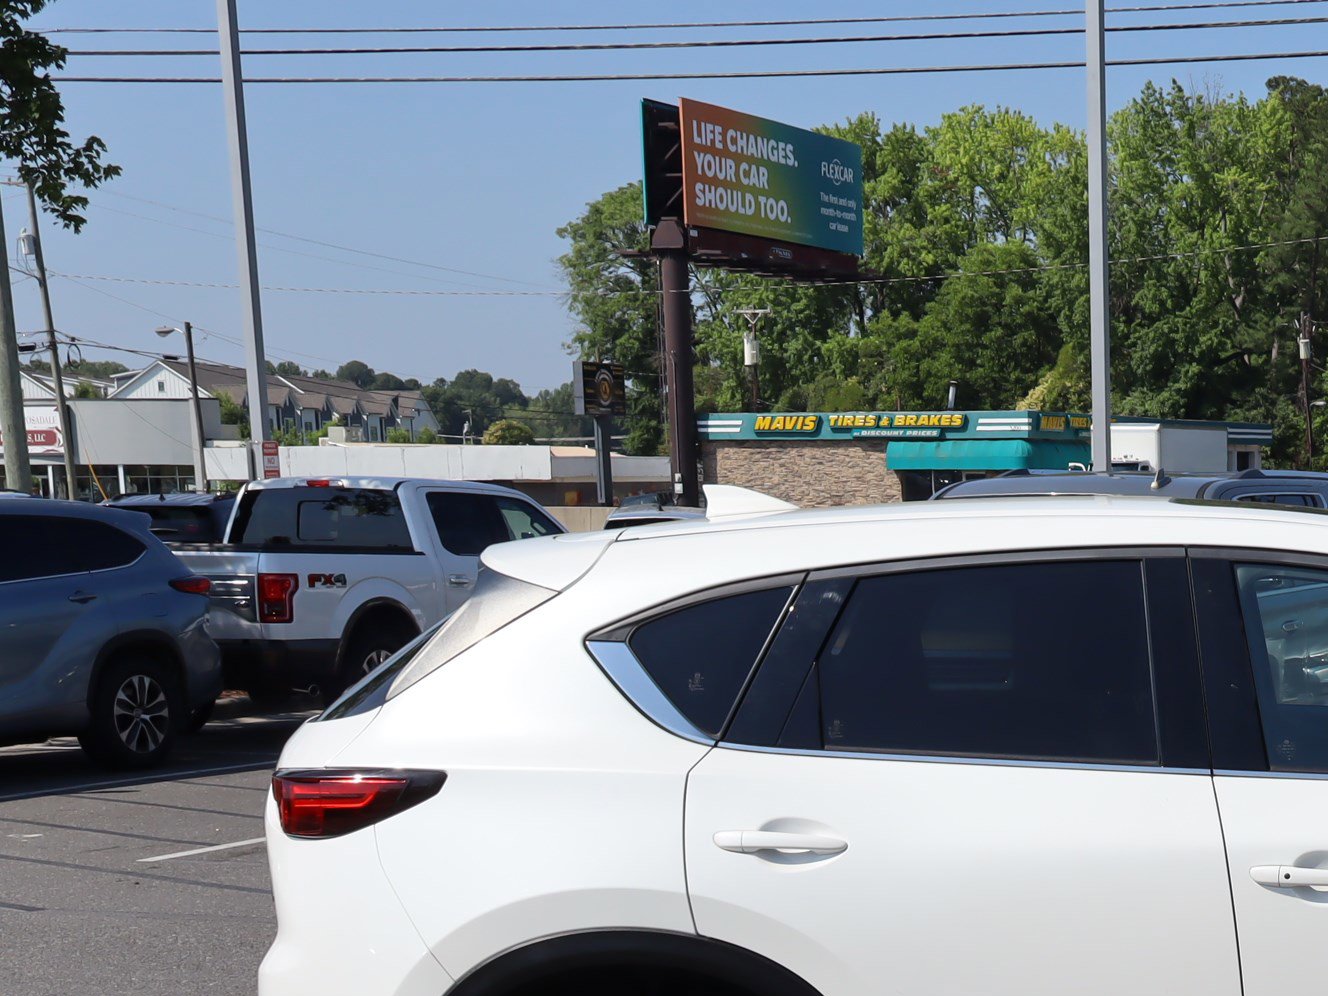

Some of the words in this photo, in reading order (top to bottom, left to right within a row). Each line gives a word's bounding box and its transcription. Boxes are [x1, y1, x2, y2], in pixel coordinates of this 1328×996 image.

[693, 120, 723, 149] LIFE
[726, 129, 798, 168] CHANGES.
[693, 151, 736, 183] YOUR
[740, 162, 768, 189] CAR
[821, 161, 854, 184] FLEXCAR
[695, 182, 756, 215] SHOULD
[758, 195, 791, 223] TOO.
[753, 415, 818, 431] MAVIS
[828, 414, 877, 427] TIRES
[878, 415, 890, 427] &
[893, 414, 963, 427] BRAKES
[1039, 415, 1066, 431] MAVIS
[307, 573, 347, 588] FX4
